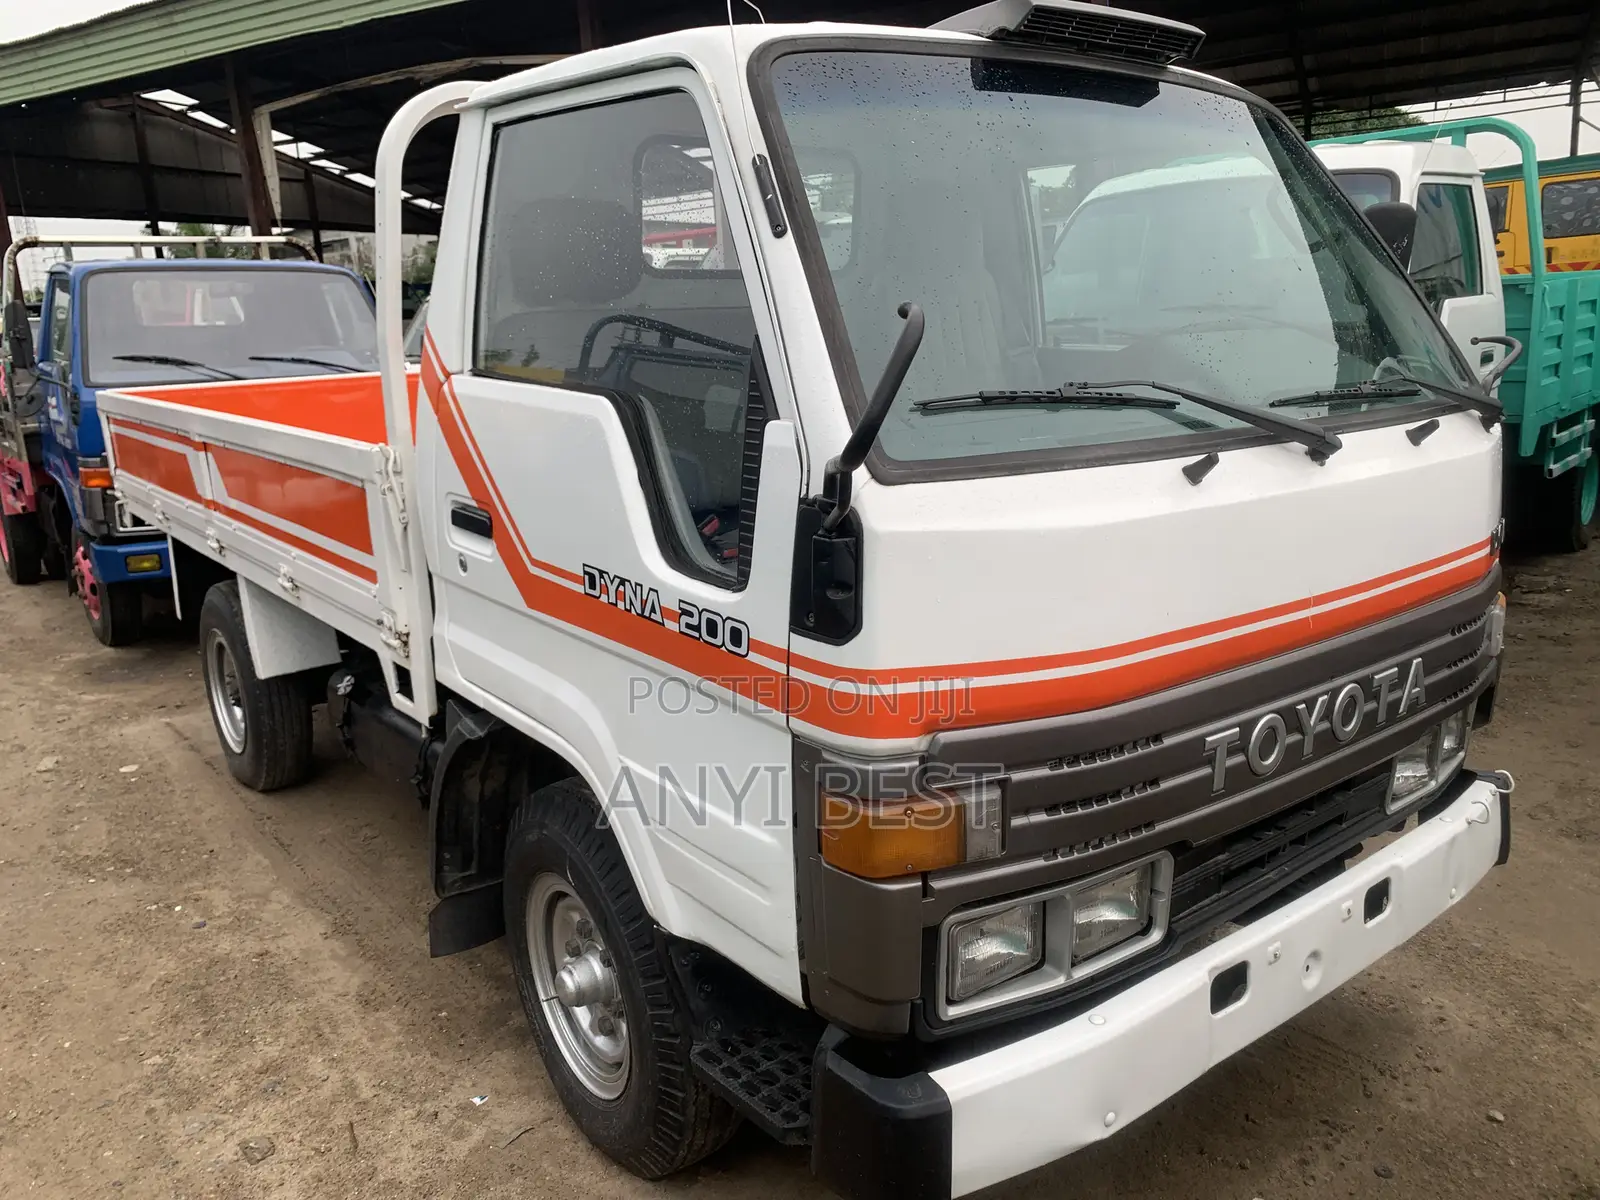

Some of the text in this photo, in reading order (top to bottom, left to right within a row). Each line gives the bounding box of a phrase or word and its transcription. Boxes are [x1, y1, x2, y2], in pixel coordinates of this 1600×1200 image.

[582, 563, 750, 658] DYNA 200
[1203, 656, 1428, 796] TOYOTA
